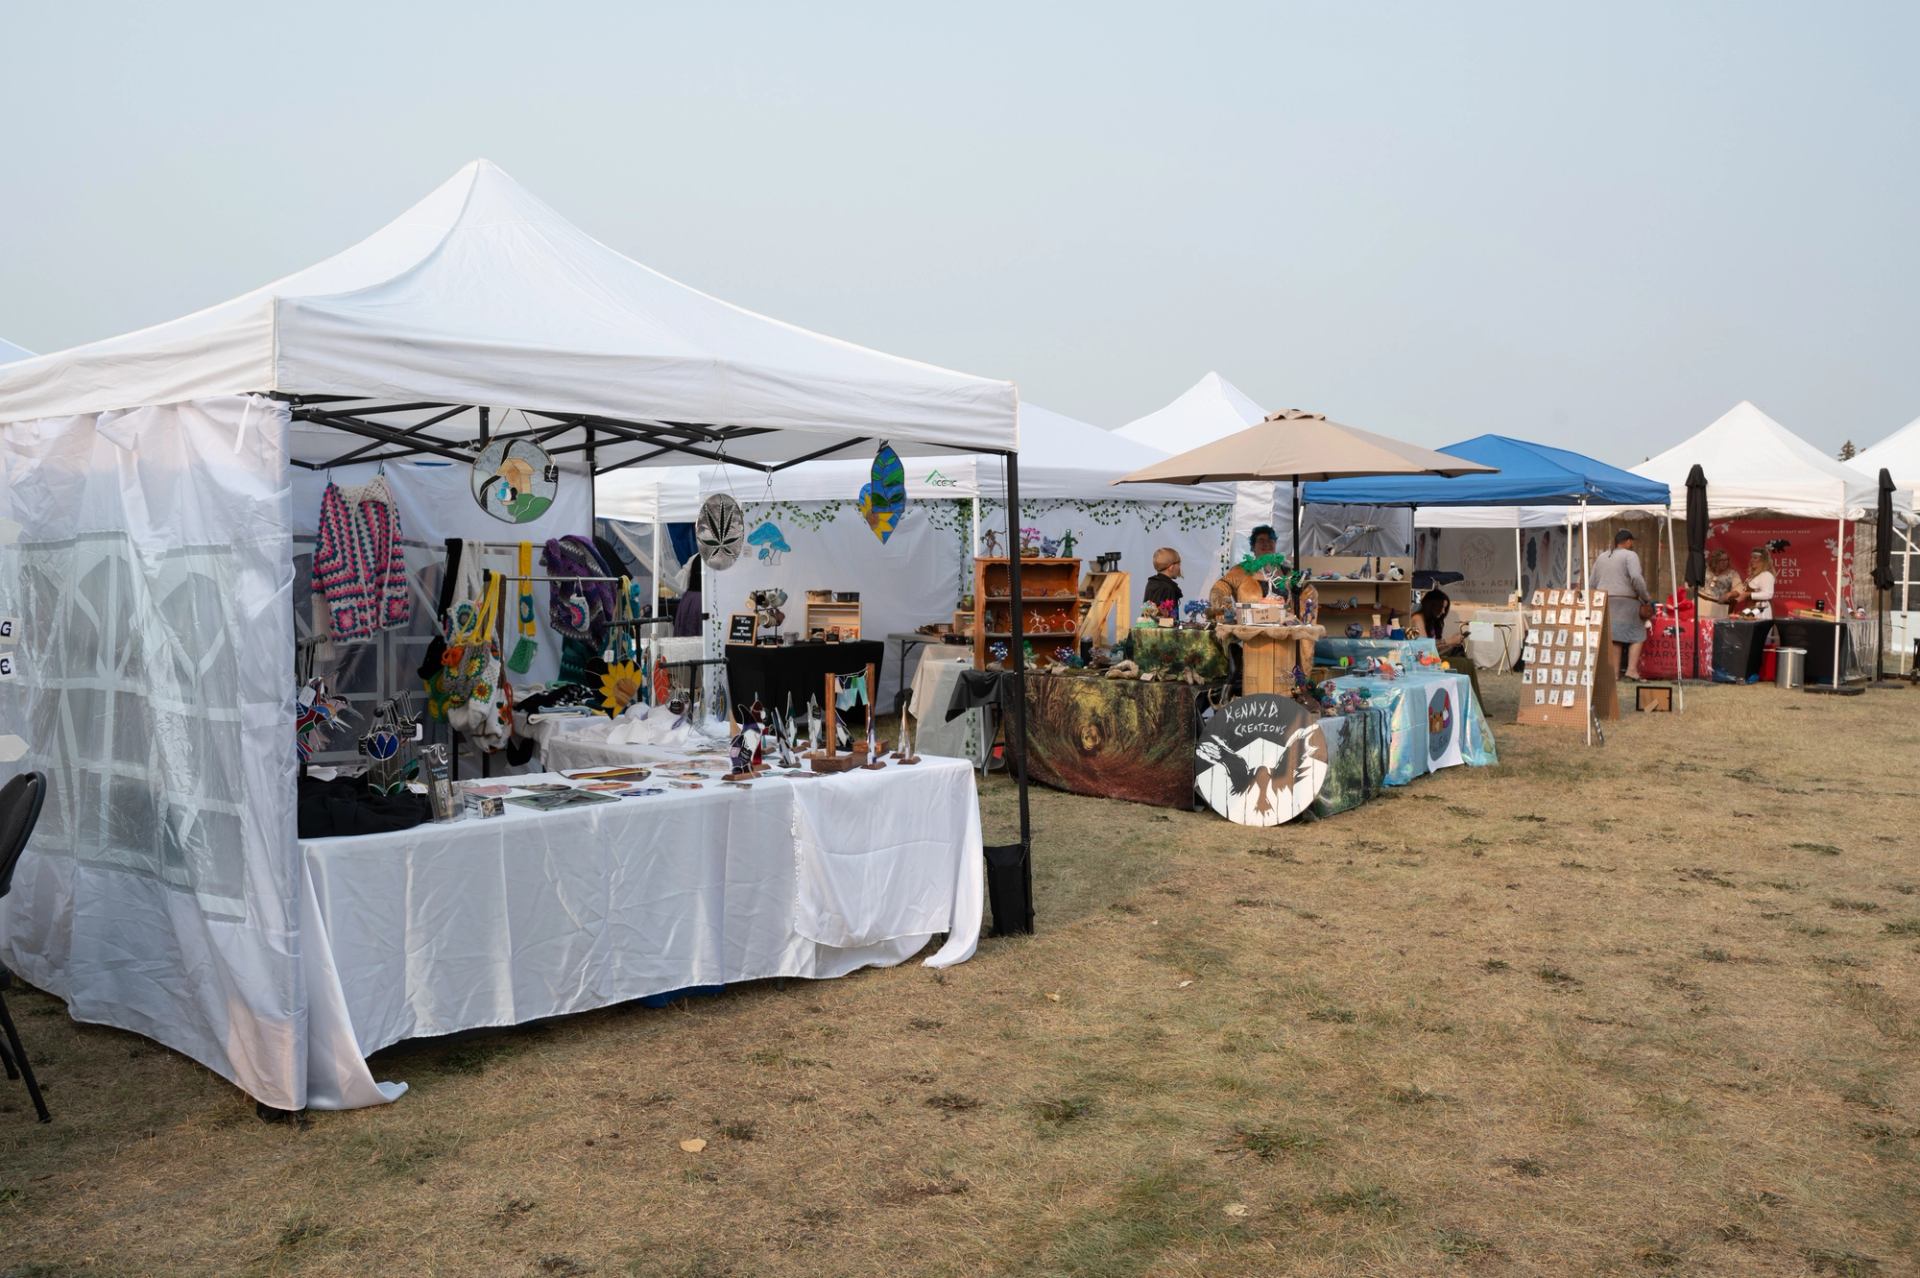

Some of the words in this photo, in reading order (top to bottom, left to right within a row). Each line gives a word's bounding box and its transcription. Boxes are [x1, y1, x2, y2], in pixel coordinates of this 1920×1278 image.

[1774, 558, 1797, 567] LEN
[1775, 568, 1801, 577] VEST
[0, 621, 12, 637] G
[1646, 650, 1692, 660] HARVES
[0, 658, 12, 675] E
[1234, 722, 1287, 737] CREATIONS
